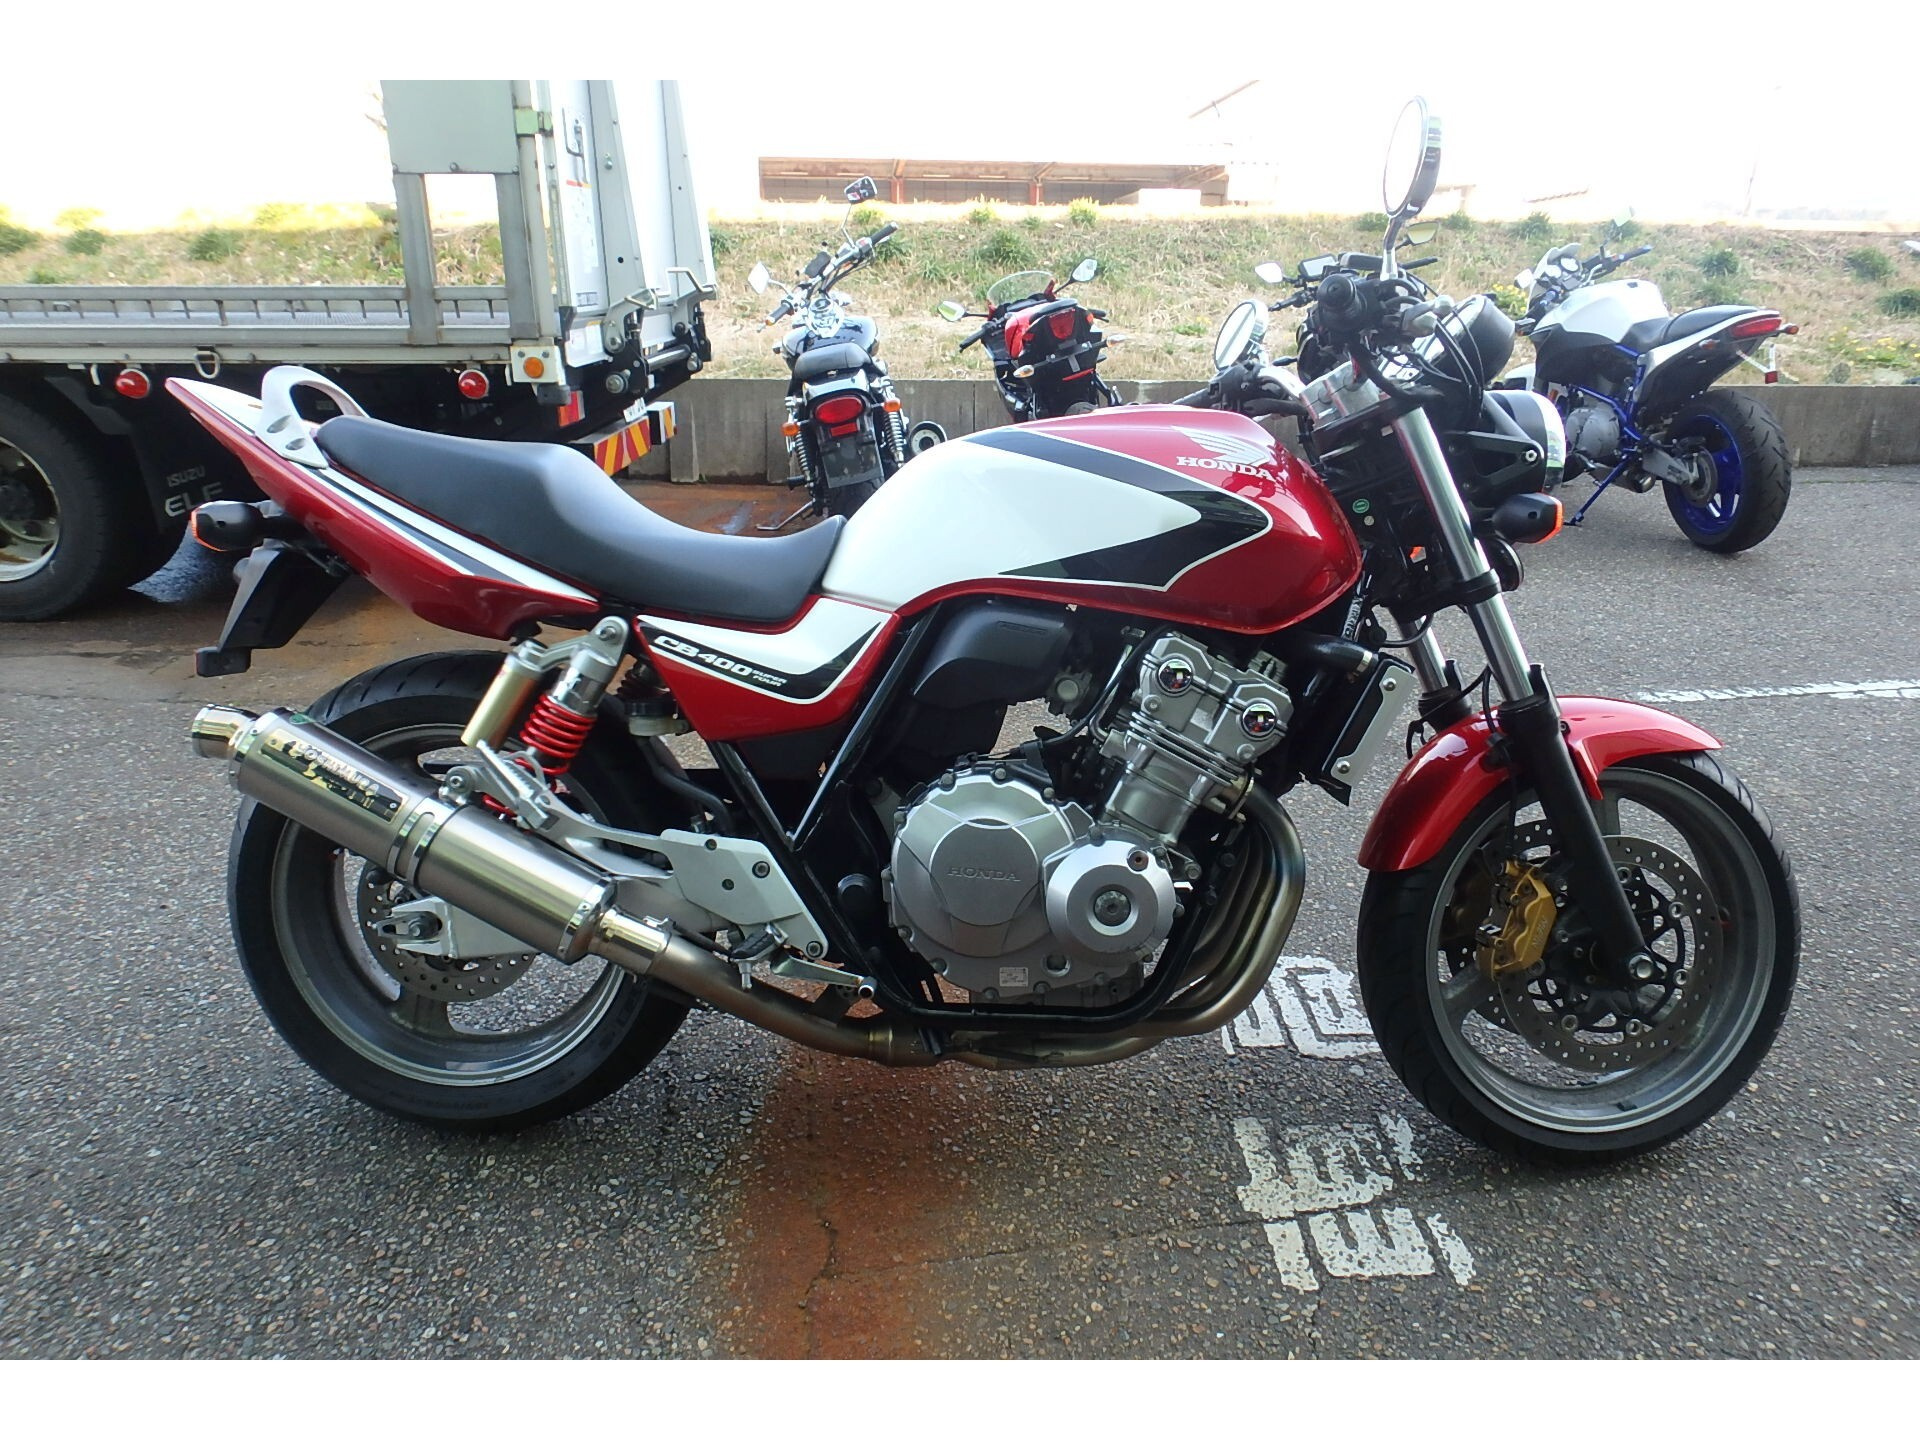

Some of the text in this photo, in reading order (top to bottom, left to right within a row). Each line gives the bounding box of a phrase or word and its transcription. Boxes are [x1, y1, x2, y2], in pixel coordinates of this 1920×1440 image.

[166, 465, 205, 487] ISUZU
[1176, 455, 1277, 483] HONDA
[165, 481, 223, 517] ELF
[653, 635, 753, 676] CB400
[752, 669, 788, 684] SUPER
[752, 674, 782, 687] FOUR
[946, 866, 1021, 882] HONDA
